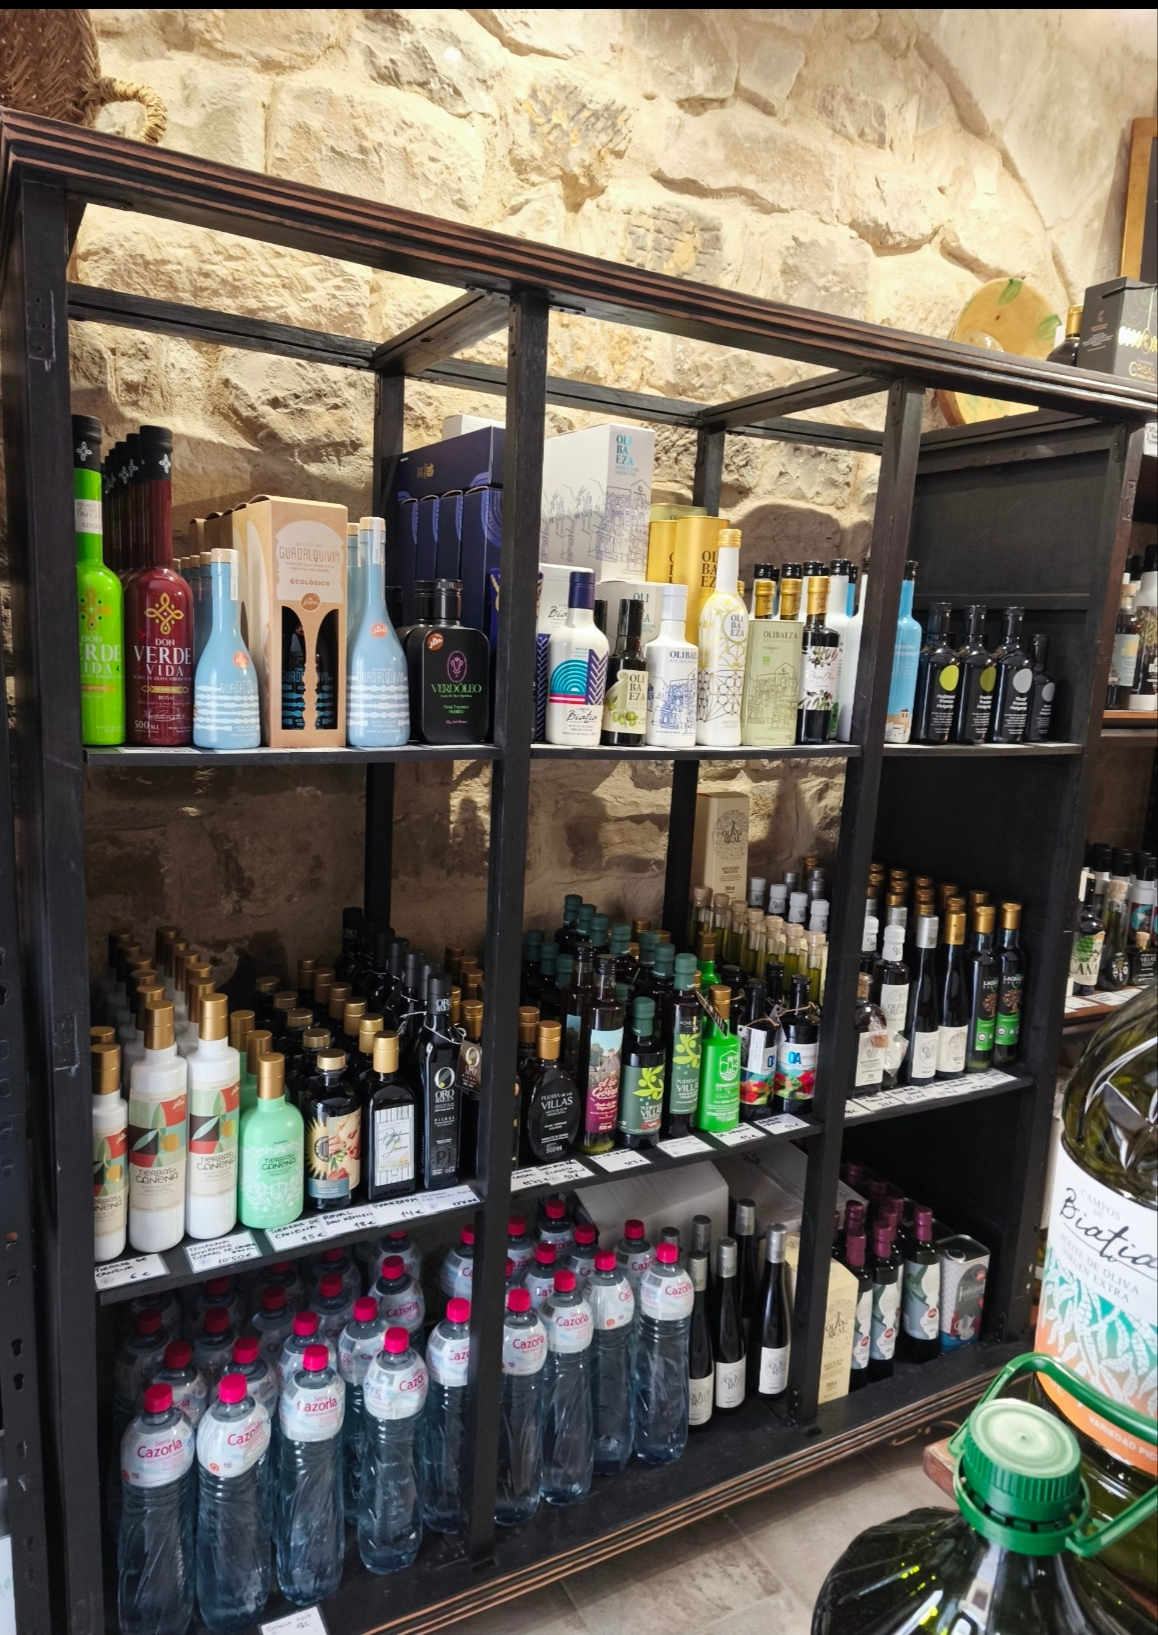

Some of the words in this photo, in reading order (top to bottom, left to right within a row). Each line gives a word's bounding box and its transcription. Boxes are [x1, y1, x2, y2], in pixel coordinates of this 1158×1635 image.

[616, 434, 633, 446] OLI
[617, 444, 628, 455] BA
[616, 454, 634, 466] EZA
[279, 546, 341, 563] GUADALQUIVIR
[290, 578, 330, 587] ECOLÓGICO
[730, 614, 743, 622] OLI
[730, 622, 742, 630] BA
[730, 629, 744, 637] EZA
[763, 630, 798, 640] OLIBAEZA
[155, 638, 175, 647] DON
[133, 645, 192, 665] VERDE
[145, 663, 184, 677] VIDA
[629, 673, 645, 683] OLI
[431, 682, 482, 694] VERDÓLEO
[630, 683, 642, 692] BA
[629, 692, 646, 701] EZA
[541, 1093, 560, 1101] PUERTA
[541, 1096, 573, 1110] VILLAS
[1081, 1189, 1121, 1221] CAMPOS
[1059, 1187, 1157, 1269] Biatia
[1060, 1233, 1084, 1261] ACEITE
[1087, 1256, 1099, 1271] DE
[1103, 1265, 1140, 1296] OLIVA
[1062, 1247, 1090, 1277] VIRGEN
[1093, 1275, 1129, 1303] EXTRA
[1088, 1414, 1137, 1451] VARIEDAD
[137, 1438, 183, 1459] Cazorla
